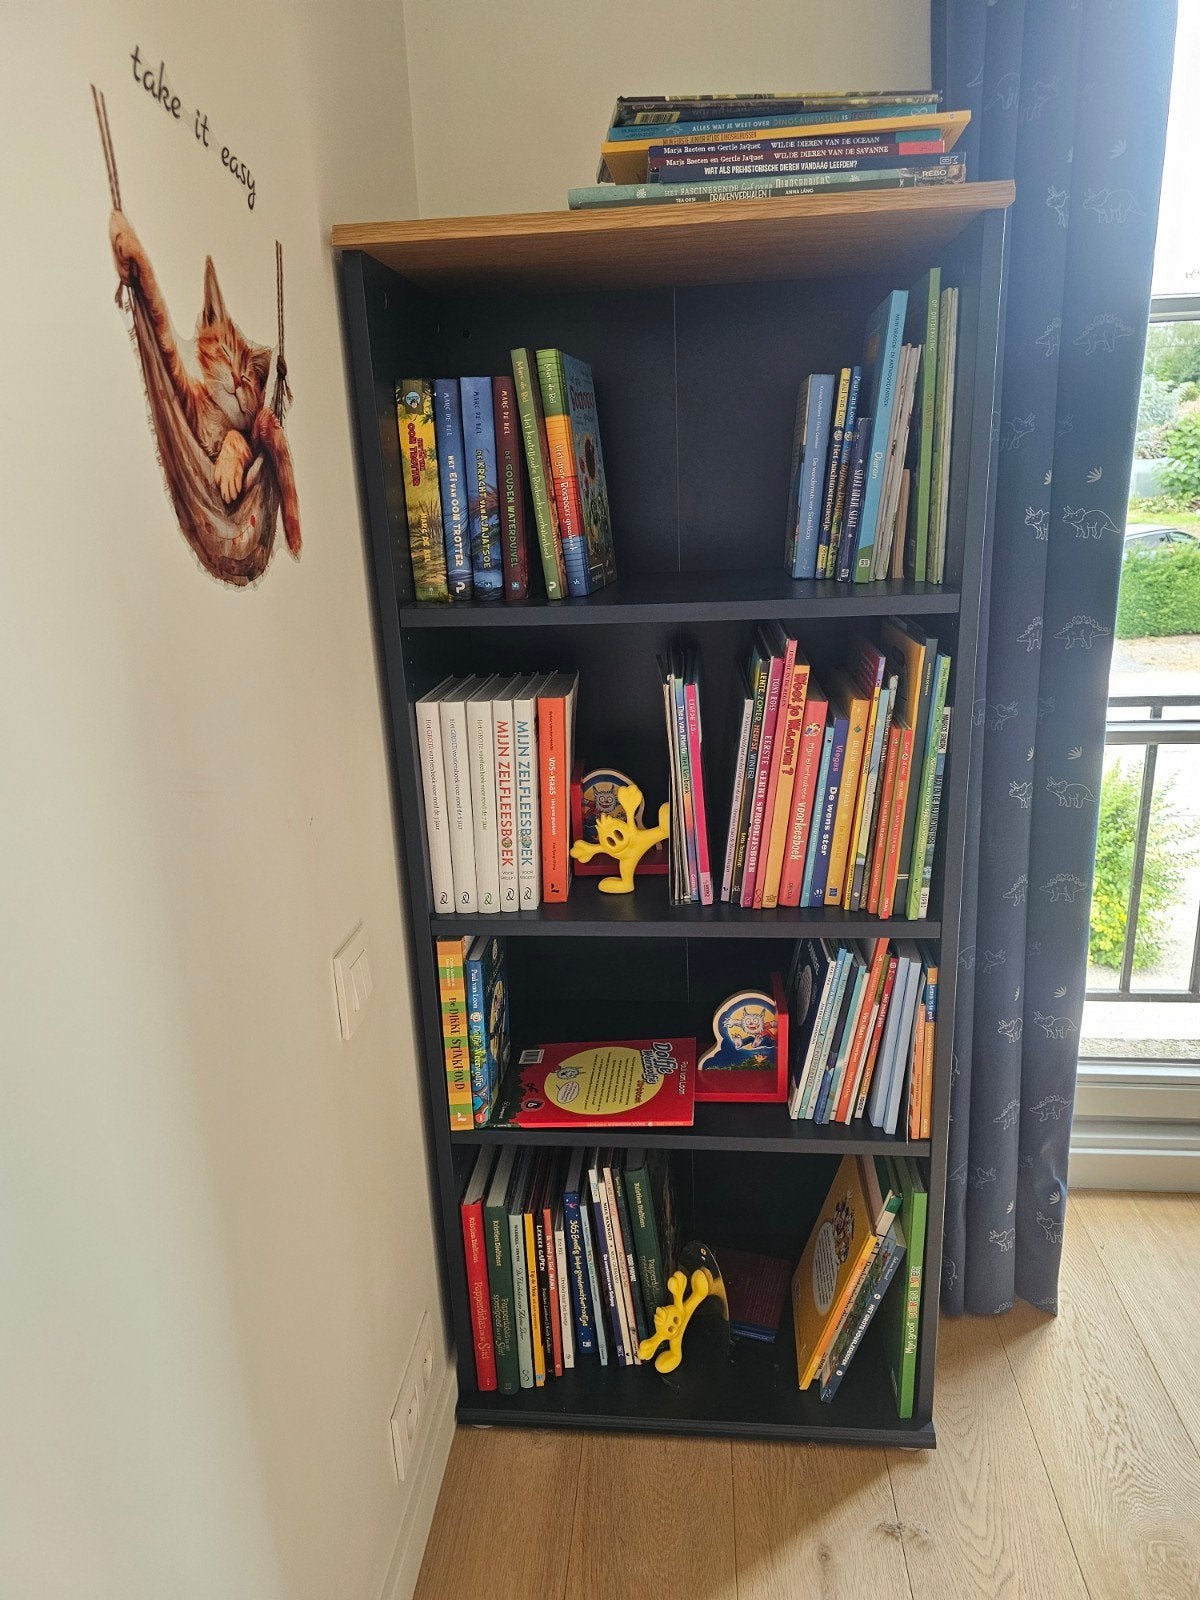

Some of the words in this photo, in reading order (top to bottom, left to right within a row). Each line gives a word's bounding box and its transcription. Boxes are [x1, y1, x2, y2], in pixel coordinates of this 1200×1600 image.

[130, 45, 182, 119] take
[195, 110, 209, 148] it
[221, 146, 256, 210] easy
[691, 124, 710, 133] ALLES
[711, 123, 725, 131] WAT
[726, 122, 733, 130] JE
[734, 121, 751, 129] WEET
[753, 119, 770, 128] OVER
[739, 142, 761, 151] Jaquet
[770, 140, 793, 149] WILDE
[796, 139, 822, 147] DIEREN
[824, 138, 839, 146] VAN
[841, 137, 851, 145] DE
[852, 135, 879, 144] OCEAAN
[665, 158, 684, 167] Marja
[709, 156, 718, 164] en
[741, 153, 763, 162] Jaquet
[773, 151, 798, 160] WILDE
[800, 149, 827, 158] DIEREN
[828, 148, 844, 157] VAN
[845, 147, 856, 156] DE
[856, 145, 889, 155] SAVANNE
[703, 166, 717, 176] WAT
[718, 165, 730, 175] ALS
[730, 163, 778, 174] PREHISTORISCHE
[778, 162, 800, 172] DIEREN
[800, 160, 828, 171] VANDAAG
[828, 158, 857, 169] LEEFDEN?
[708, 188, 767, 202] DRAKENVERHALEN
[930, 299, 937, 307] OP
[928, 311, 937, 351] ONTDEKKING
[518, 380, 528, 390] de
[546, 383, 556, 391] de
[840, 377, 848, 394] Paul
[852, 375, 861, 391] Paul
[443, 392, 451, 410] MARC
[472, 390, 480, 409] MARC
[500, 390, 509, 408] MARC
[519, 390, 530, 403] Bel
[548, 391, 557, 404] Bel
[838, 393, 846, 407] van
[850, 390, 859, 405] van
[444, 413, 451, 421] DE
[473, 412, 481, 420] DE
[502, 411, 509, 420] DE
[522, 412, 533, 430] Het
[847, 405, 857, 425] Loon
[407, 422, 416, 444] OOM
[474, 422, 482, 434] BEL
[502, 422, 510, 435] BEL
[475, 449, 482, 460] DE
[504, 450, 511, 460] DE
[832, 443, 841, 459] Het
[409, 445, 420, 486] TROTTER
[870, 450, 883, 481] Dieren
[476, 461, 486, 497] KRACHT
[504, 463, 515, 503] GOUDEN
[451, 498, 459, 520] OOM
[420, 512, 429, 534] MARC
[421, 536, 430, 546] DE
[452, 523, 462, 566] TROTTER
[507, 505, 519, 568] WATERDUIVEL
[422, 548, 431, 562] BEL
[770, 677, 780, 694] TONY
[677, 704, 685, 720] Thea
[768, 694, 778, 712] ROSS
[678, 721, 686, 733] van
[496, 719, 510, 757] MIJN
[516, 719, 529, 757] MIJN
[761, 734, 772, 765] EERSTE
[804, 741, 815, 757] Mijn
[830, 743, 843, 772] Viegas
[681, 756, 689, 767] het
[746, 752, 757, 780] WINTER
[827, 785, 838, 801] De
[822, 803, 834, 831] wens
[789, 800, 810, 861] voorleesboek
[819, 832, 831, 856] ster
[447, 996, 457, 1008] De
[471, 993, 479, 1009] Loon
[448, 1007, 461, 1035] DIKKE
[471, 1024, 481, 1047] Dolfje
[652, 1041, 679, 1075] Dolfje
[473, 1048, 484, 1087] Weerwolfje
[677, 1081, 687, 1095] Loon
[633, 1181, 643, 1204] Kristien
[468, 1216, 477, 1239] Kristien
[492, 1219, 500, 1242] Kristien
[569, 1218, 579, 1234] 365
[535, 1224, 544, 1249] LEKKER
[537, 1249, 546, 1272] GAPEN
[908, 1265, 921, 1288] BOEK
[472, 1280, 488, 1329] Papperdidas
[865, 1302, 875, 1314] HET
[906, 1289, 920, 1319] DIEREN
[499, 1297, 510, 1338] Papperdidas
[857, 1311, 871, 1331] GROTE
[905, 1321, 917, 1340] groot
[477, 1341, 491, 1361] Sint
[495, 1339, 505, 1356] Sint
[904, 1339, 916, 1354] Mijn
